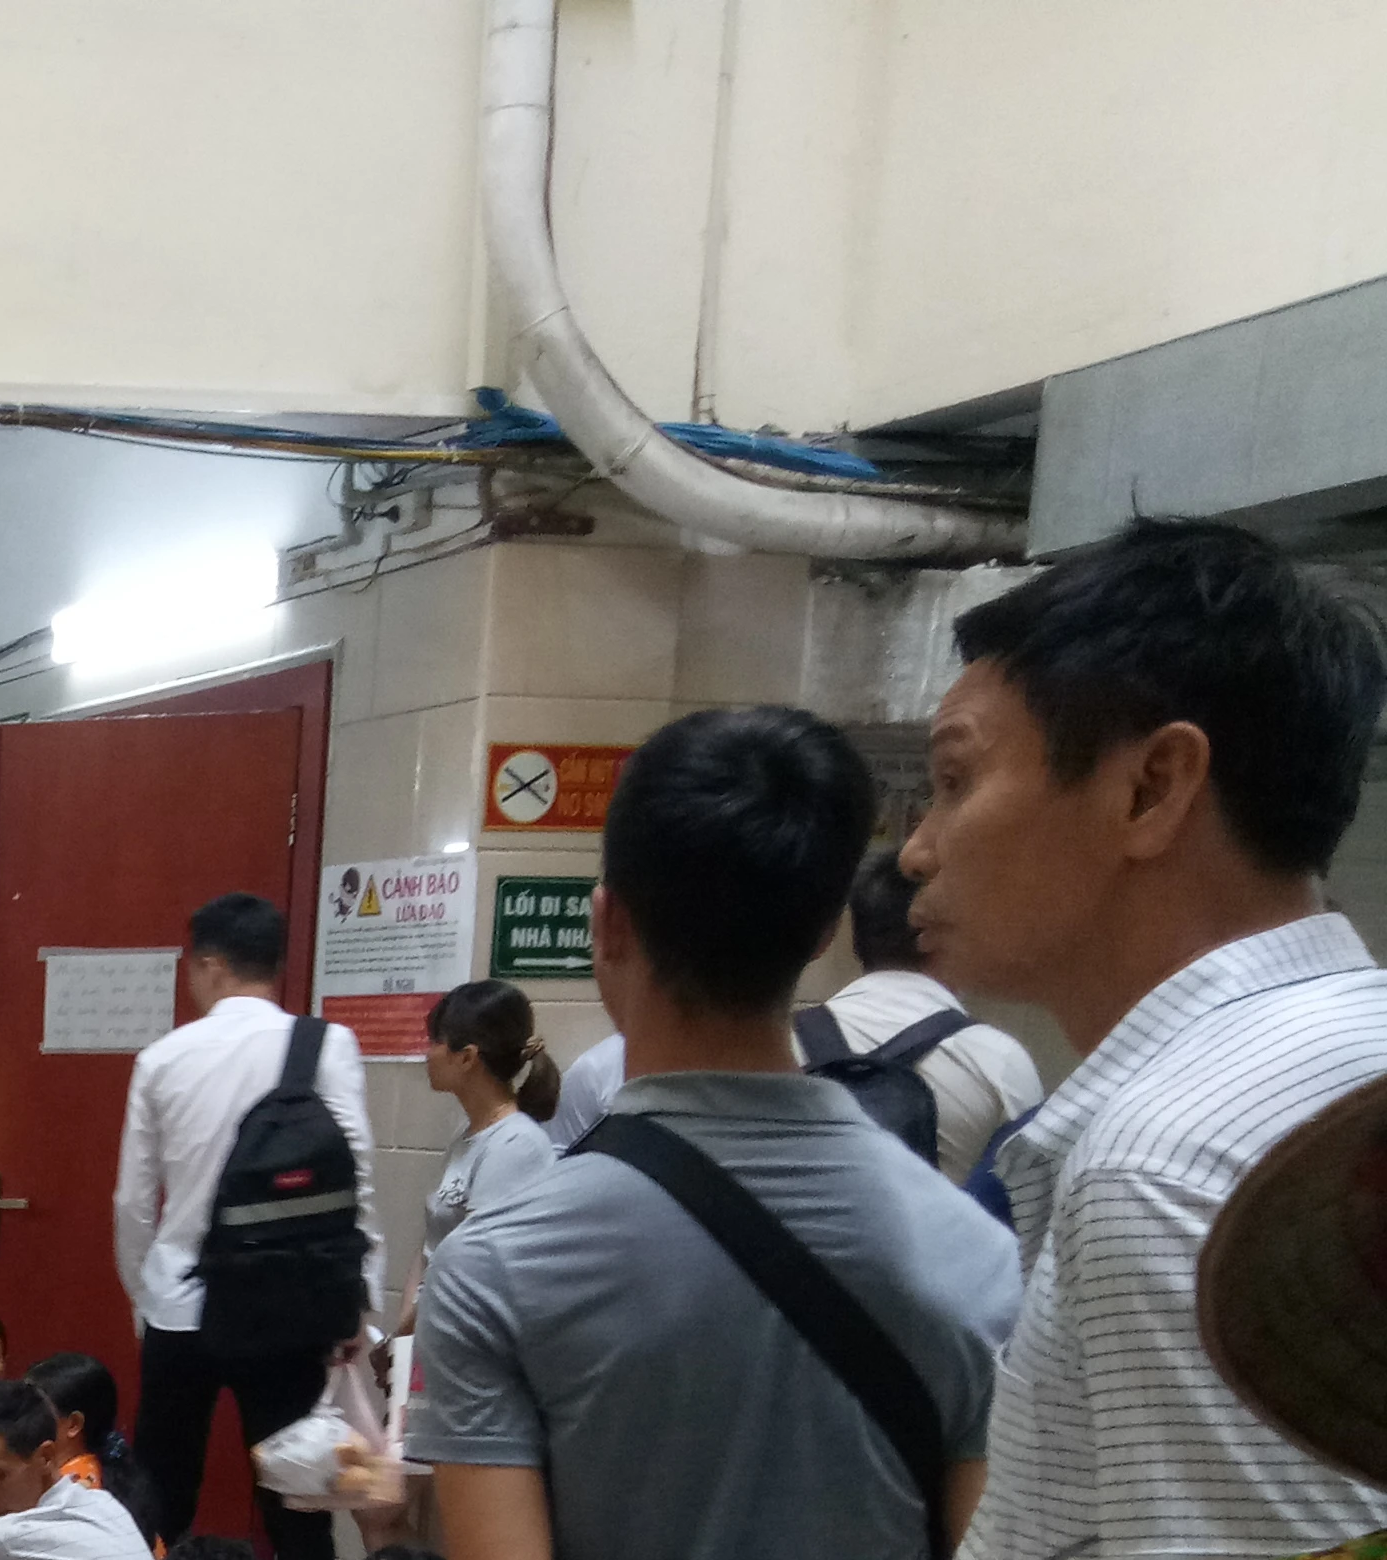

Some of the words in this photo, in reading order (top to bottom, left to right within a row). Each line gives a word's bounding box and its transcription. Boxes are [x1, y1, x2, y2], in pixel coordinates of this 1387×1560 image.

[382, 868, 423, 900] CẢNH
[426, 867, 459, 896] BÁO
[504, 889, 536, 916] LỐI
[540, 896, 561, 916] ĐI
[564, 896, 593, 916] SA
